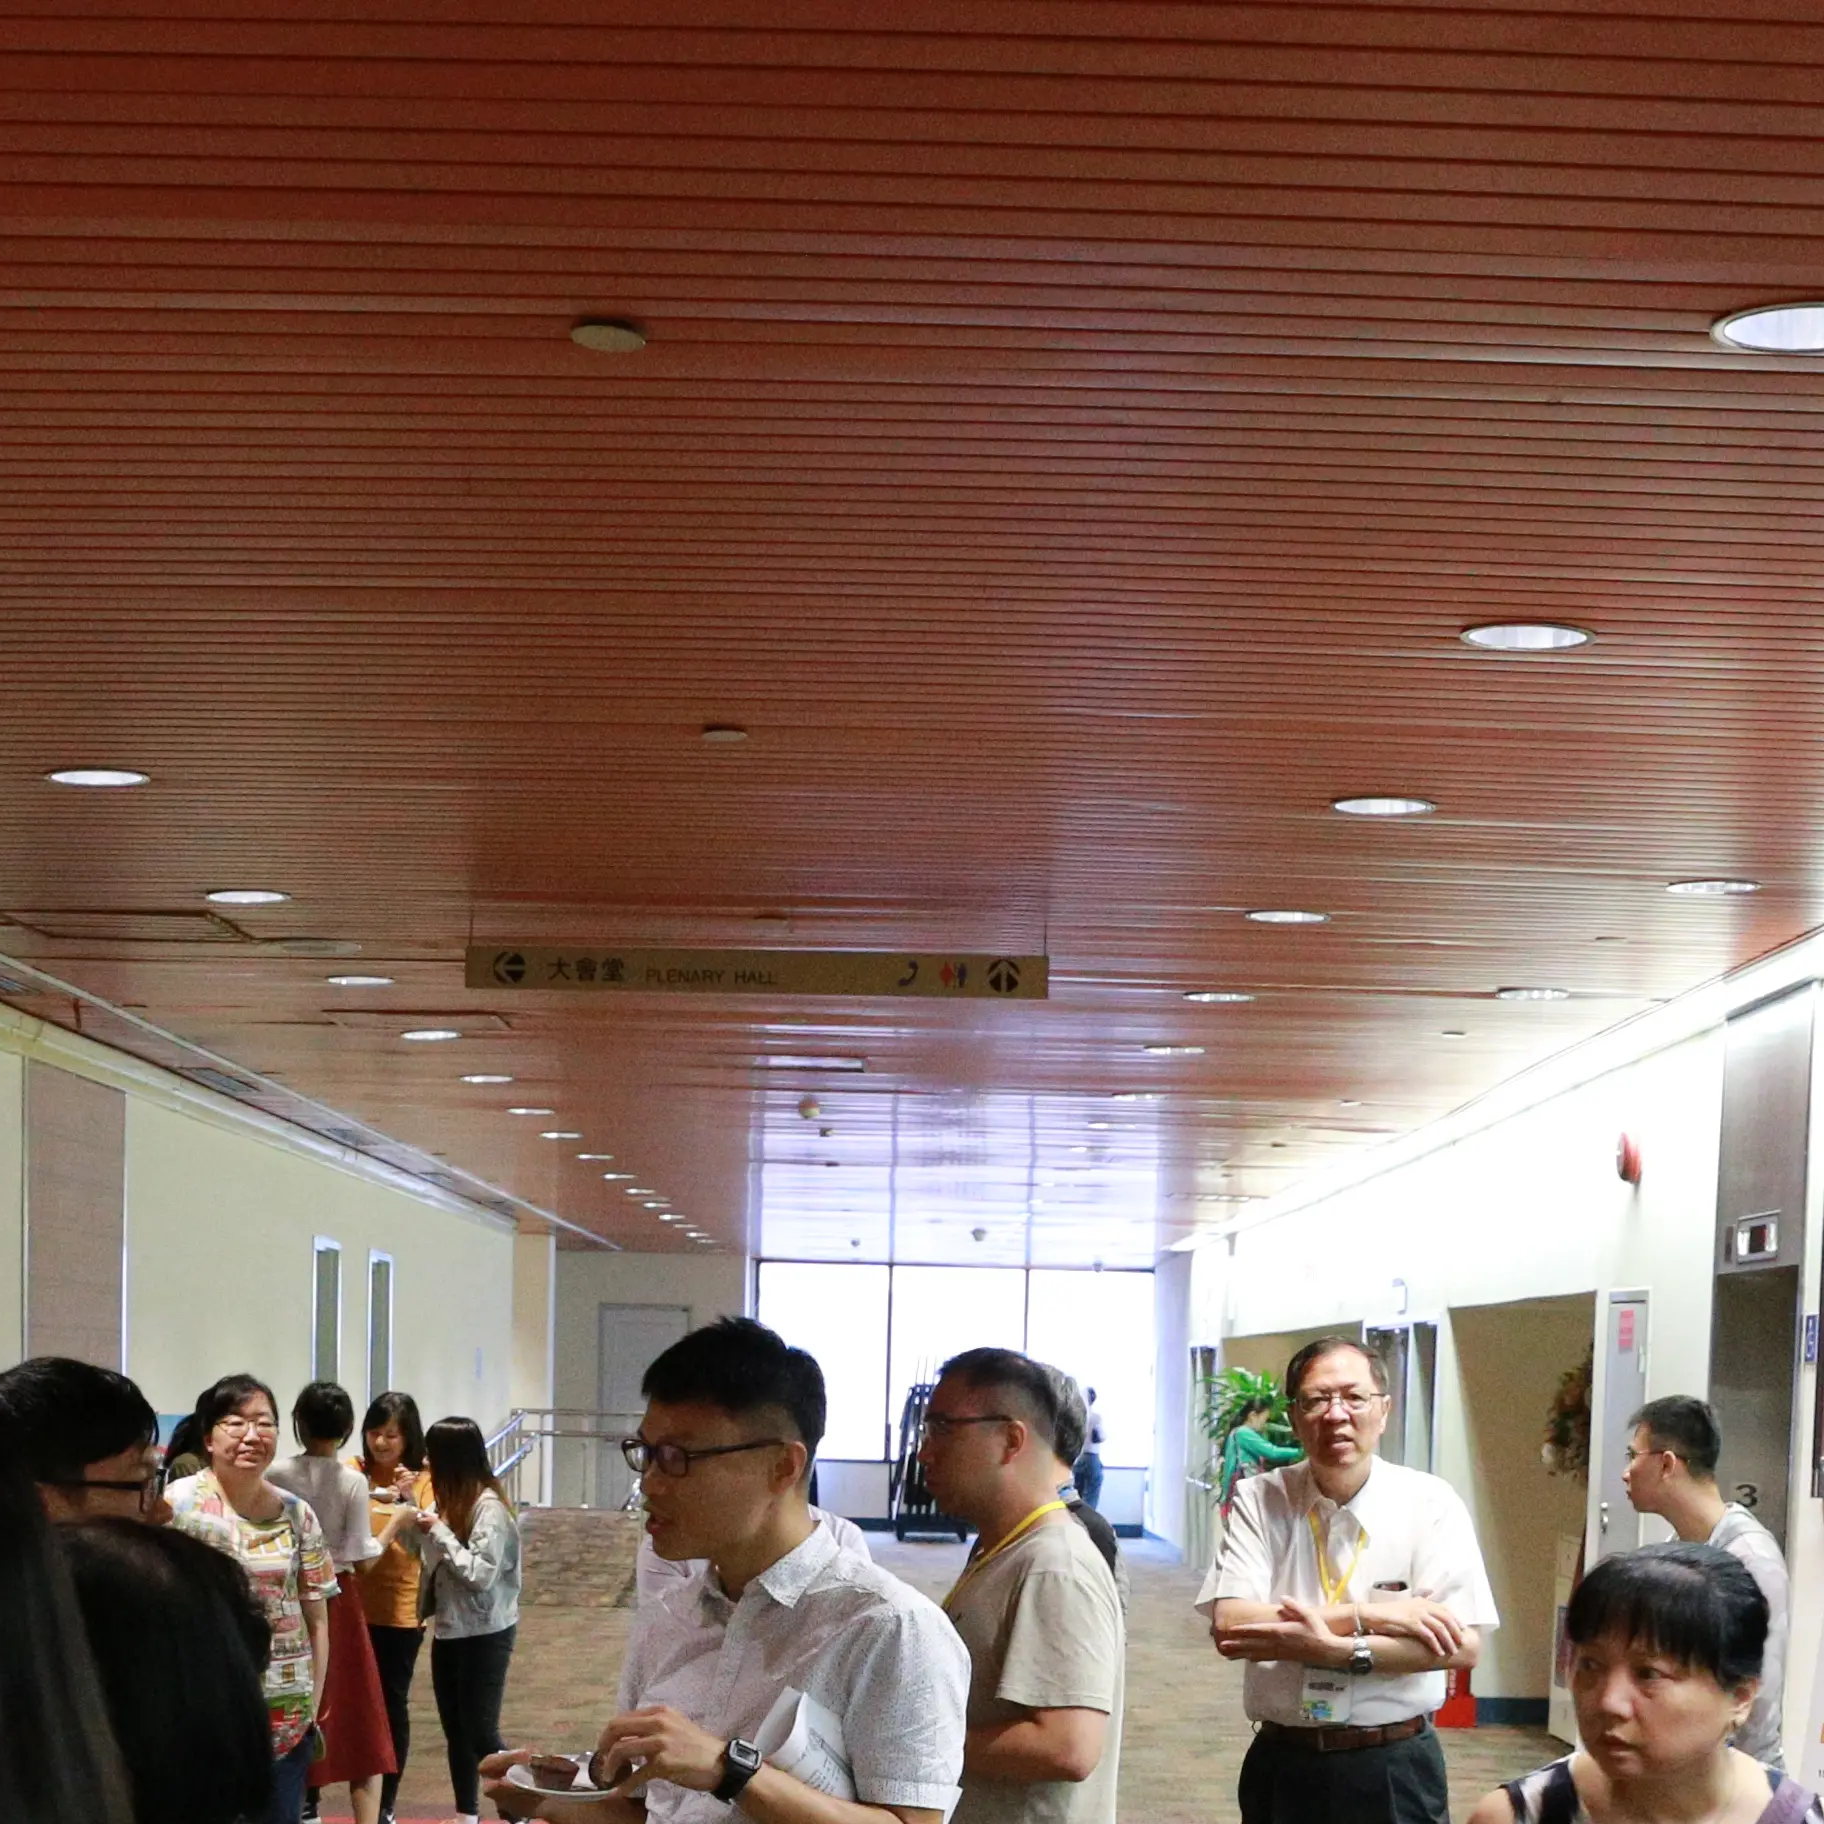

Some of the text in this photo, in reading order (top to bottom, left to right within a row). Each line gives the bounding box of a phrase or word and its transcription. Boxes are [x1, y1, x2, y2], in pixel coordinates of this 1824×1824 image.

[547, 957, 777, 986] 大會堂 PLENARY HALL
[1734, 1483, 1759, 1508] 3
